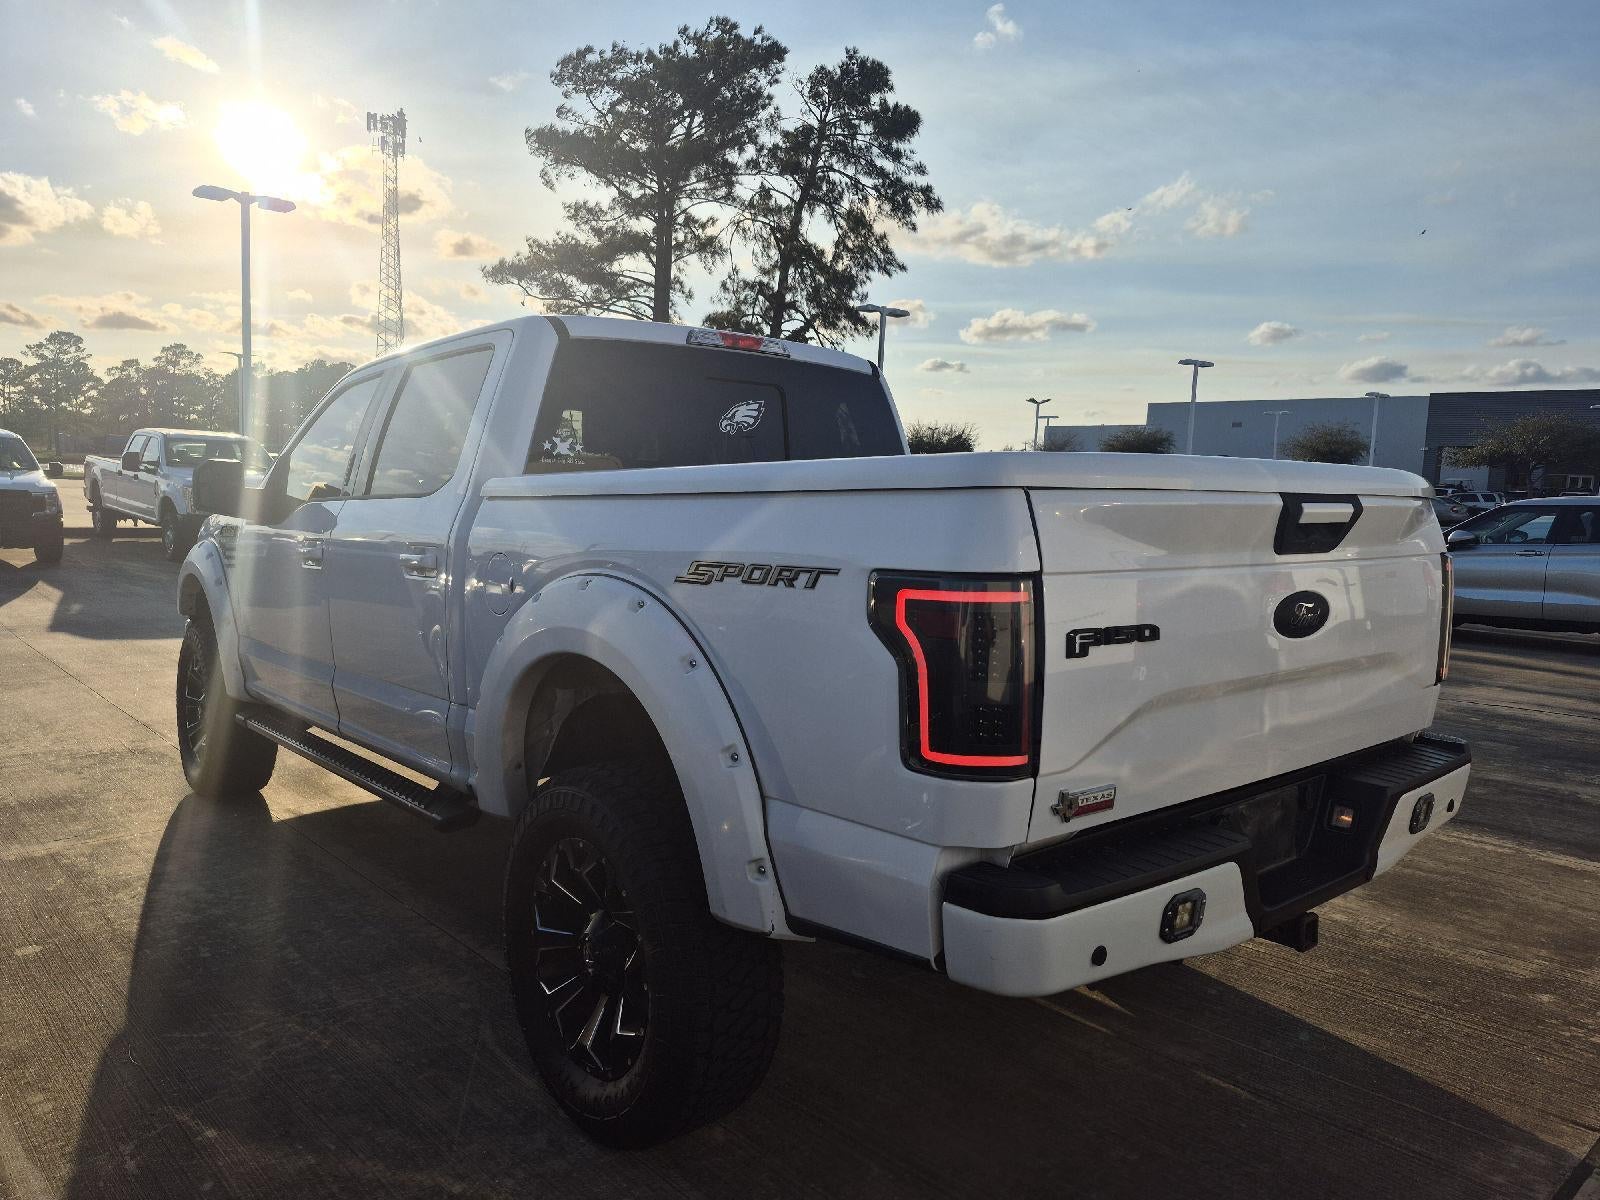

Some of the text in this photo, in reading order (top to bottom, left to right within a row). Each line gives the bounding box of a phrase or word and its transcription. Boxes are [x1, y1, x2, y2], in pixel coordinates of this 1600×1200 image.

[674, 560, 842, 590] SPORT
[1290, 602, 1321, 625] Ford
[1079, 791, 1113, 804] TEXAS
